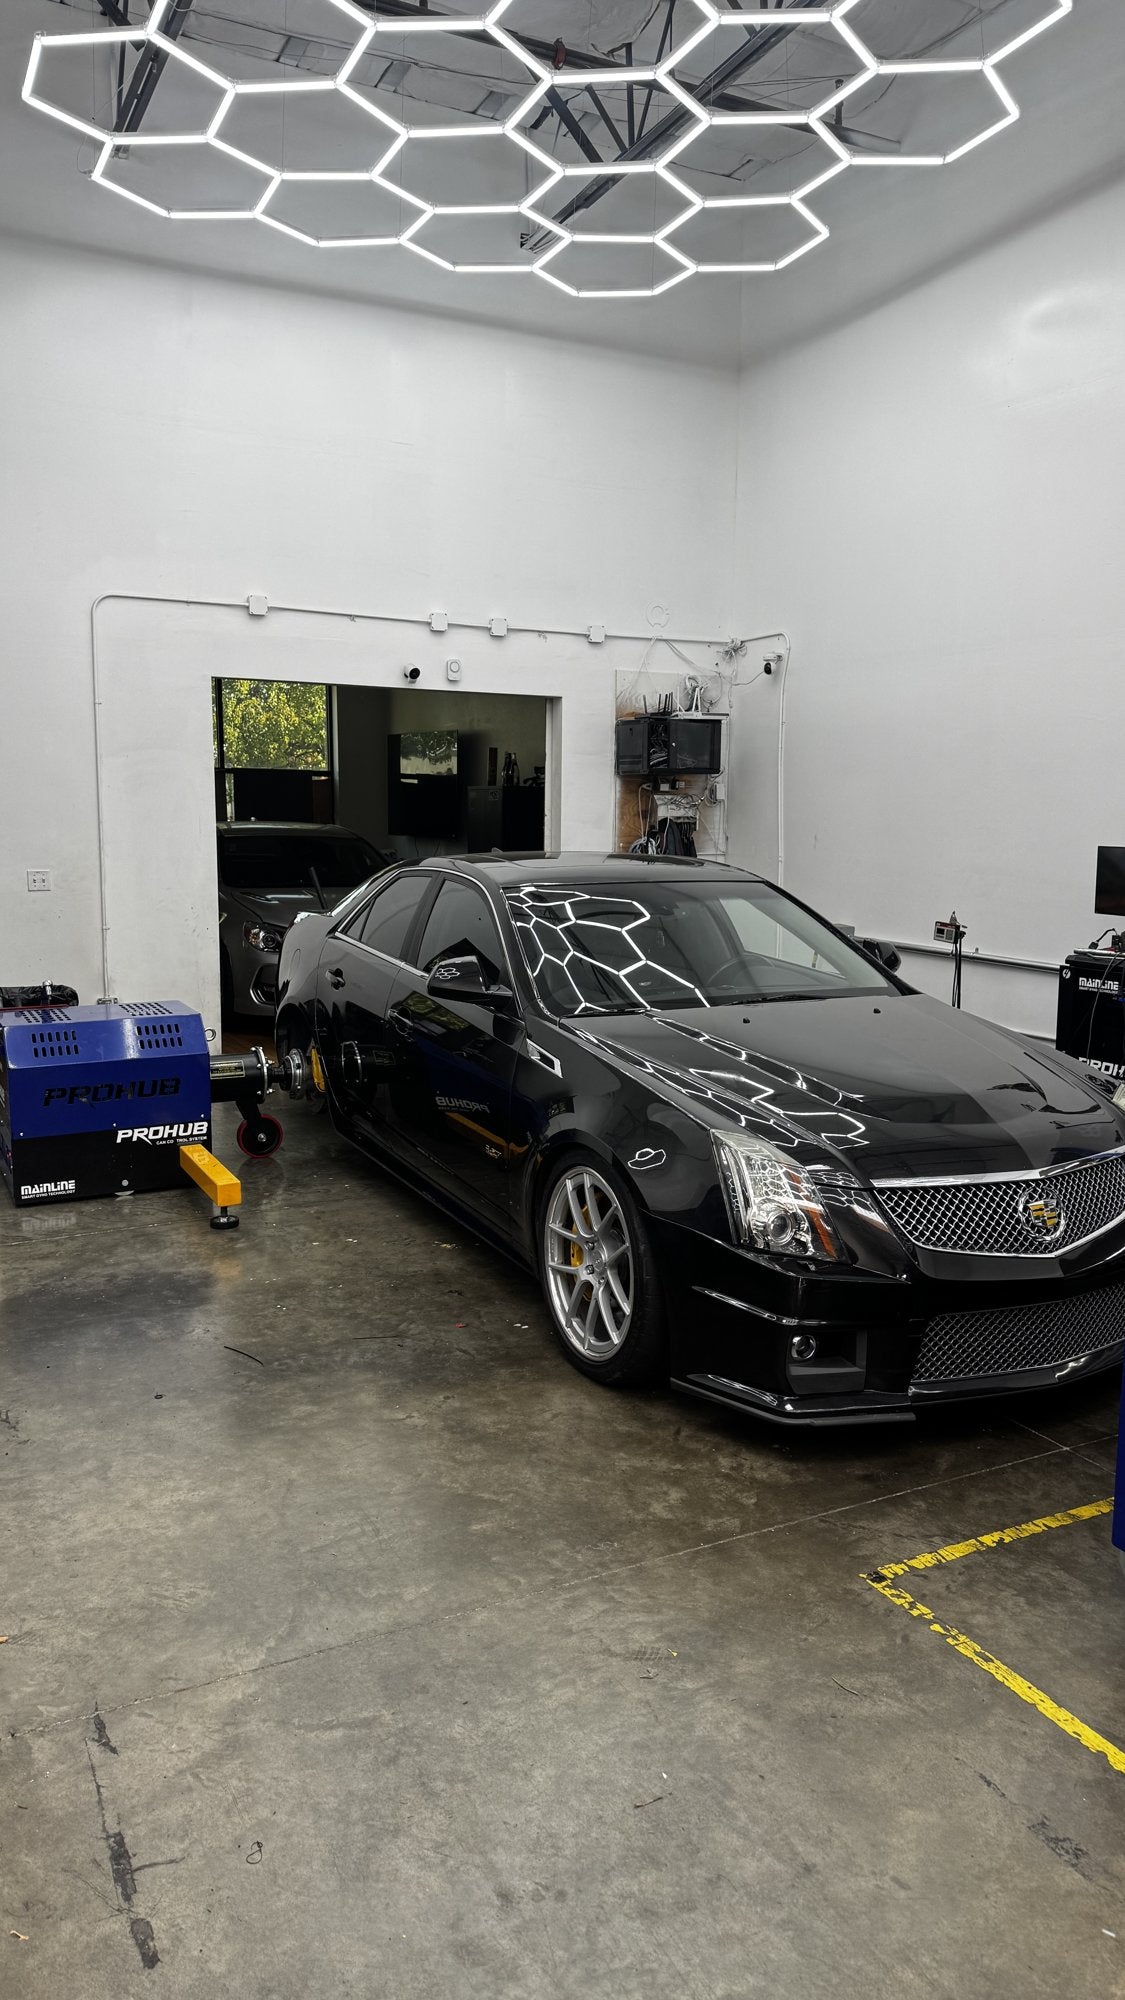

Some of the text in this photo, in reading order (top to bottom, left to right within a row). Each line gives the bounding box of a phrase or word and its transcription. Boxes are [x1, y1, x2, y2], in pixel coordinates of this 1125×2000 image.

[43, 1078, 181, 1108] PROHUB
[116, 1121, 208, 1145] PROHUB
[21, 1180, 76, 1196] MAINLINE
